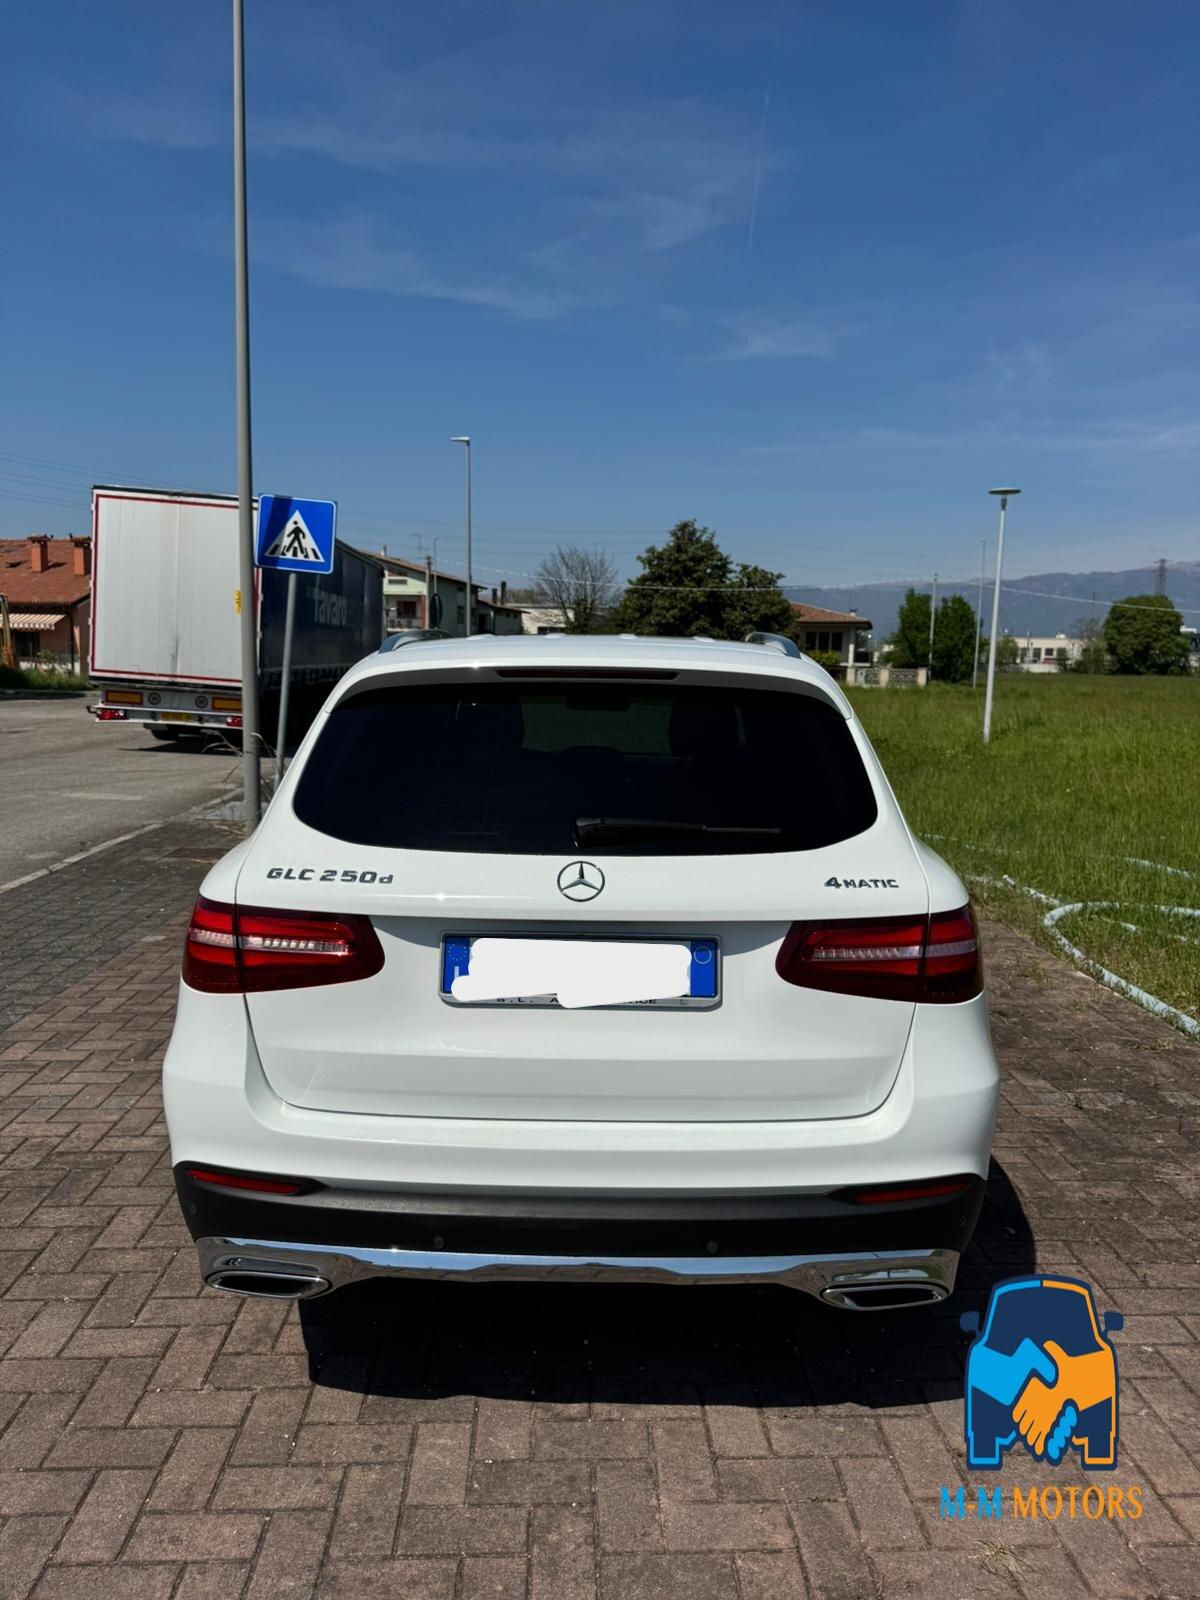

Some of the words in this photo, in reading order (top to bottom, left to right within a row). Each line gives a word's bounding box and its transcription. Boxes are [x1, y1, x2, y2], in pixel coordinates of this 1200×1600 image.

[266, 867, 316, 881] GLC
[319, 869, 394, 884] 250d
[824, 876, 900, 889] 4MATIC
